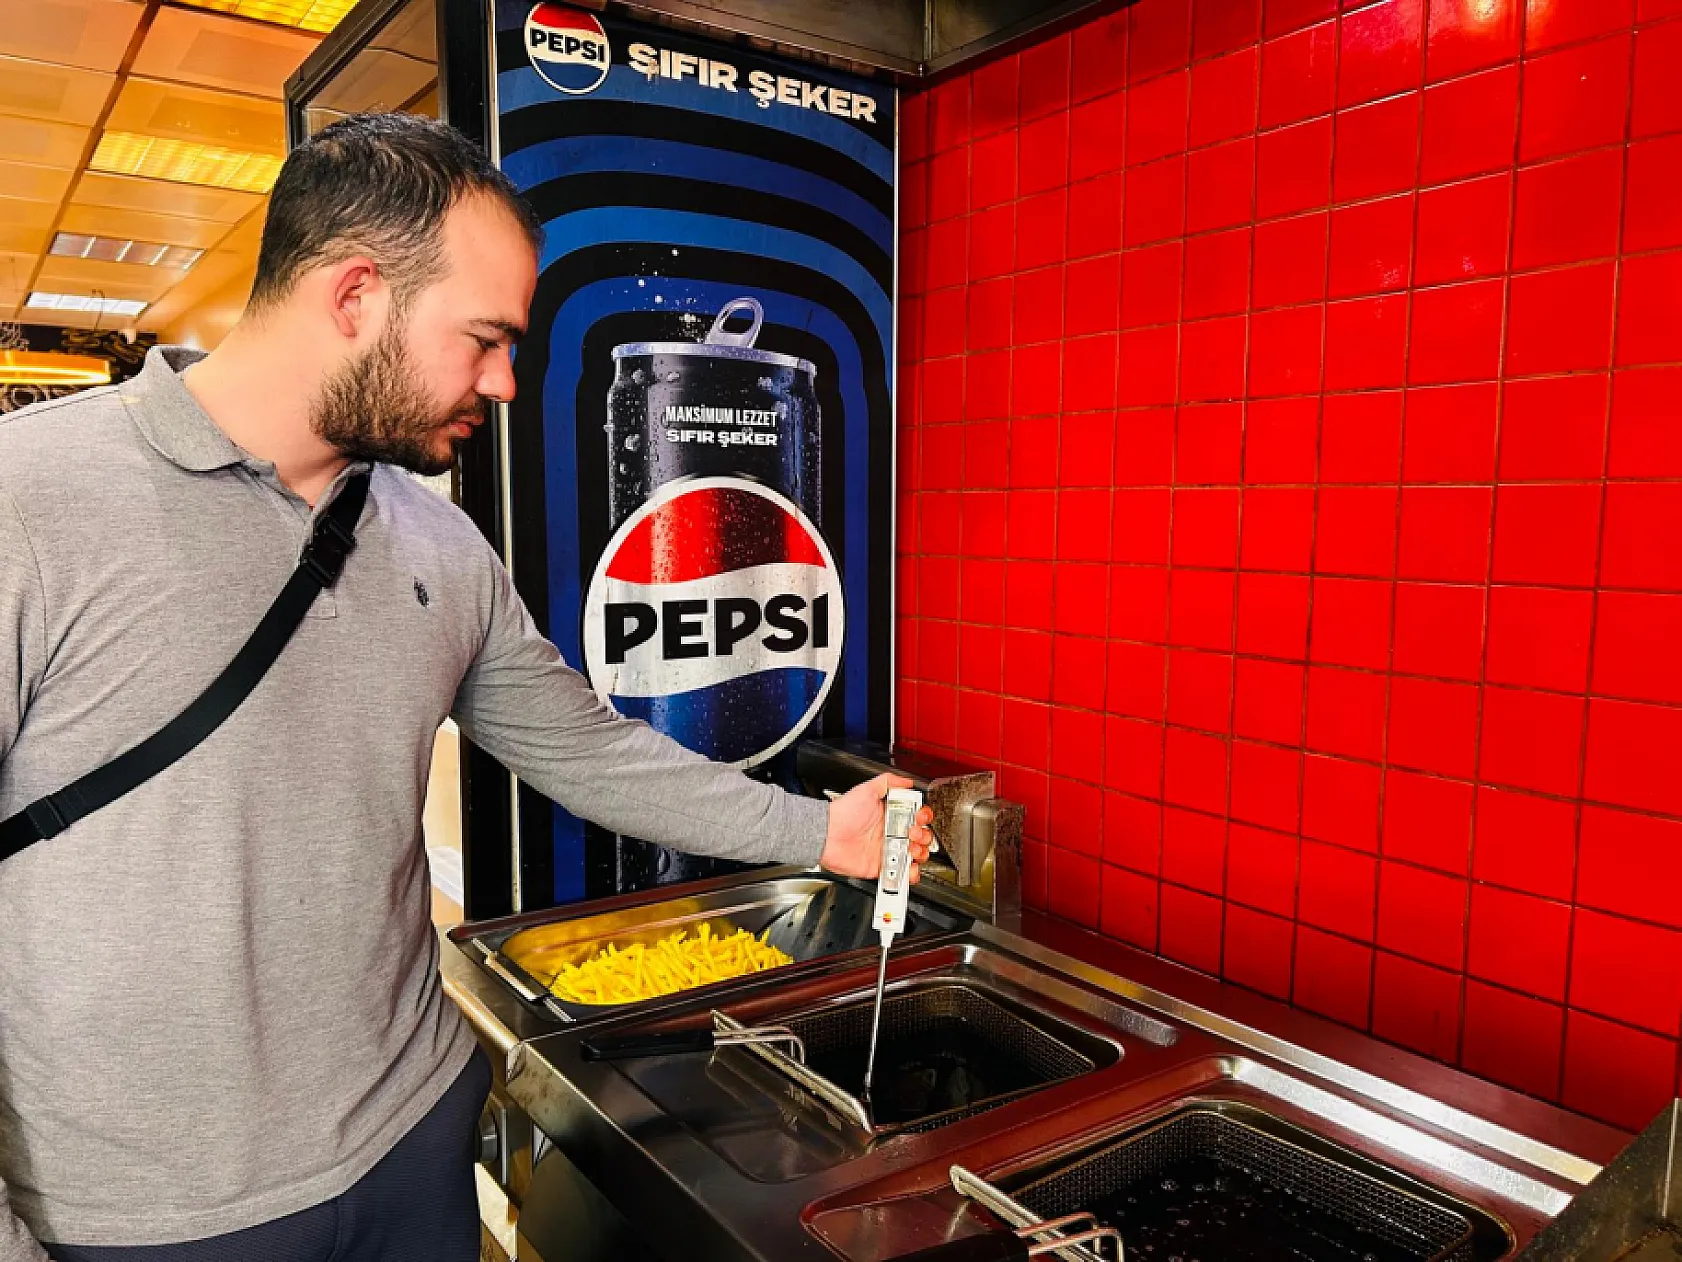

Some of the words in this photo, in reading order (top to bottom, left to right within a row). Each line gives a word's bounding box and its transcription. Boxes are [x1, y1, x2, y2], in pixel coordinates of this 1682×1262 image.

[529, 26, 605, 63] PEPSI
[627, 42, 739, 93] SIFIR
[748, 70, 877, 123] ŞEKER
[665, 403, 734, 424] MAKSİMUM
[735, 409, 778, 428] LEZZET
[665, 429, 715, 443] SIFIR
[717, 429, 778, 448] ŞEKER
[604, 592, 829, 665] PEPSI
